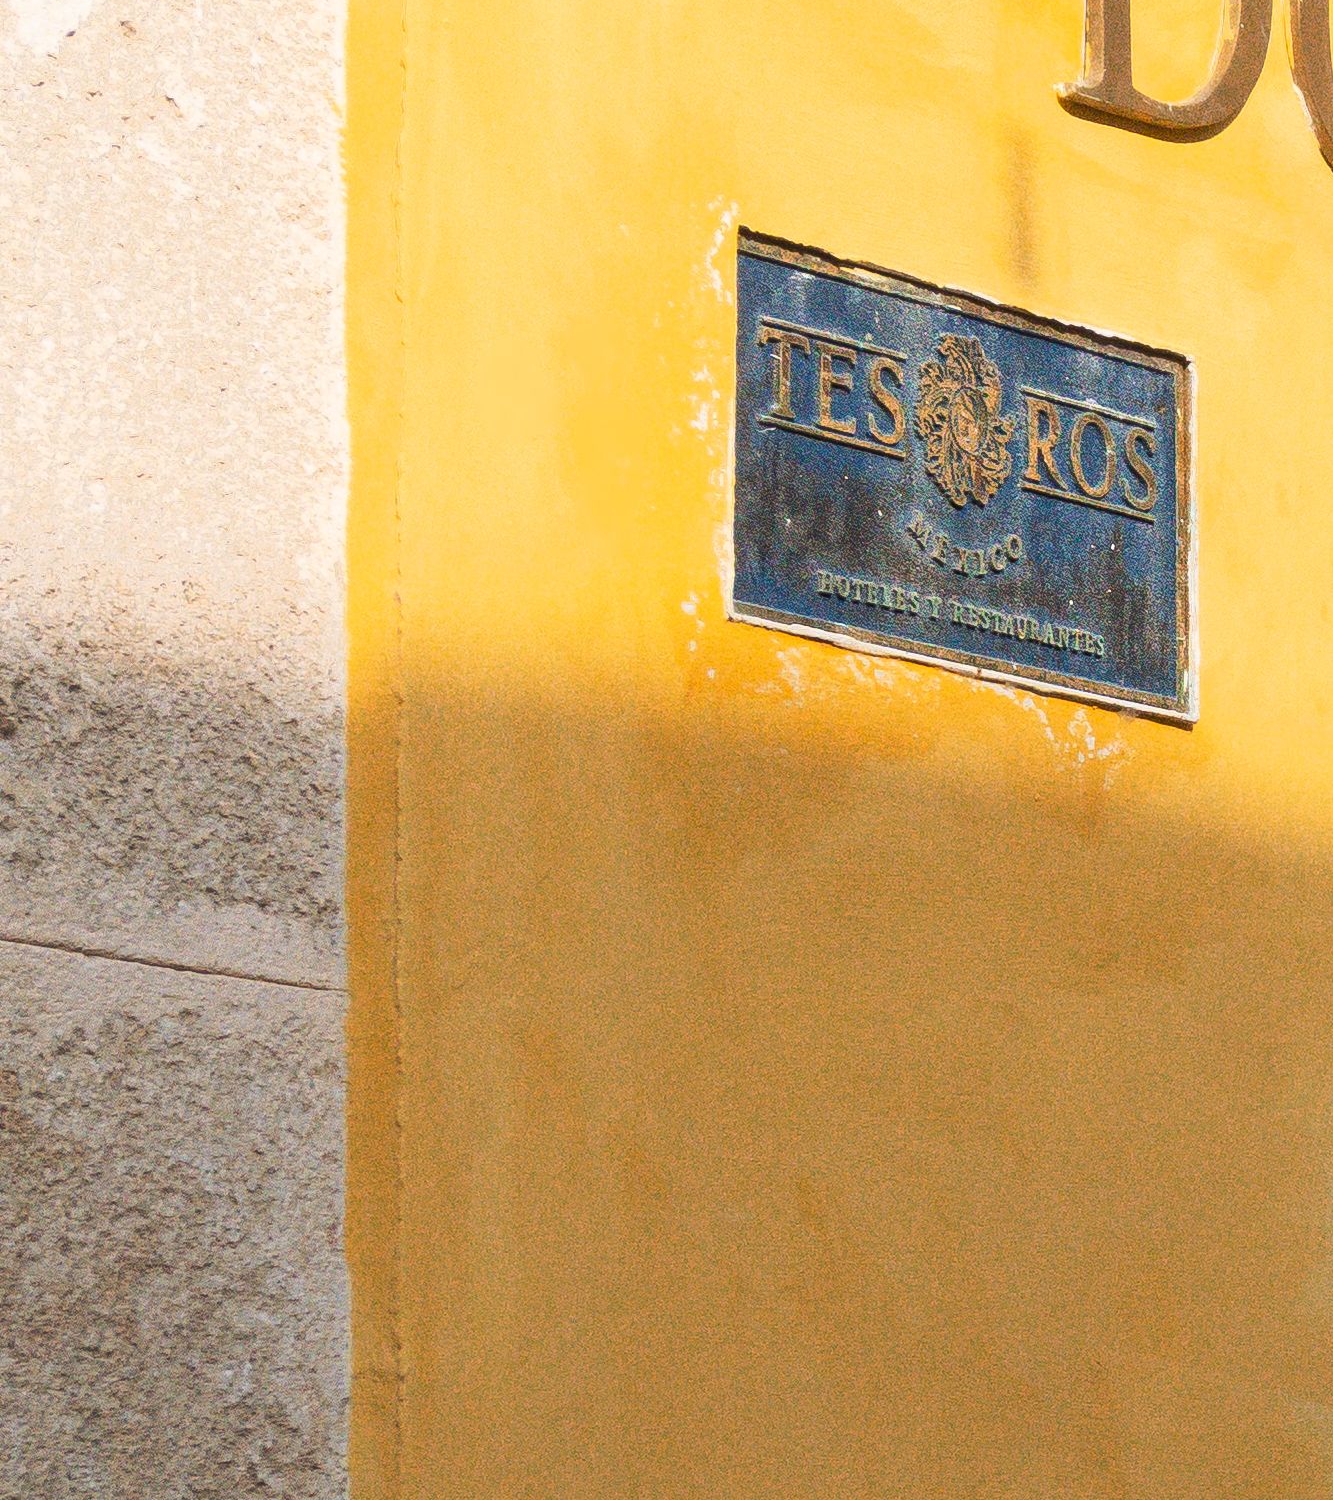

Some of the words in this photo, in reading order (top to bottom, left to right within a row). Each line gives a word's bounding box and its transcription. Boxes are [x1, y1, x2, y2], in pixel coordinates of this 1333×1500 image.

[816, 569, 920, 613] HOTELES
[925, 596, 943, 619] Y
[949, 601, 1106, 658] RESTAURANTES
